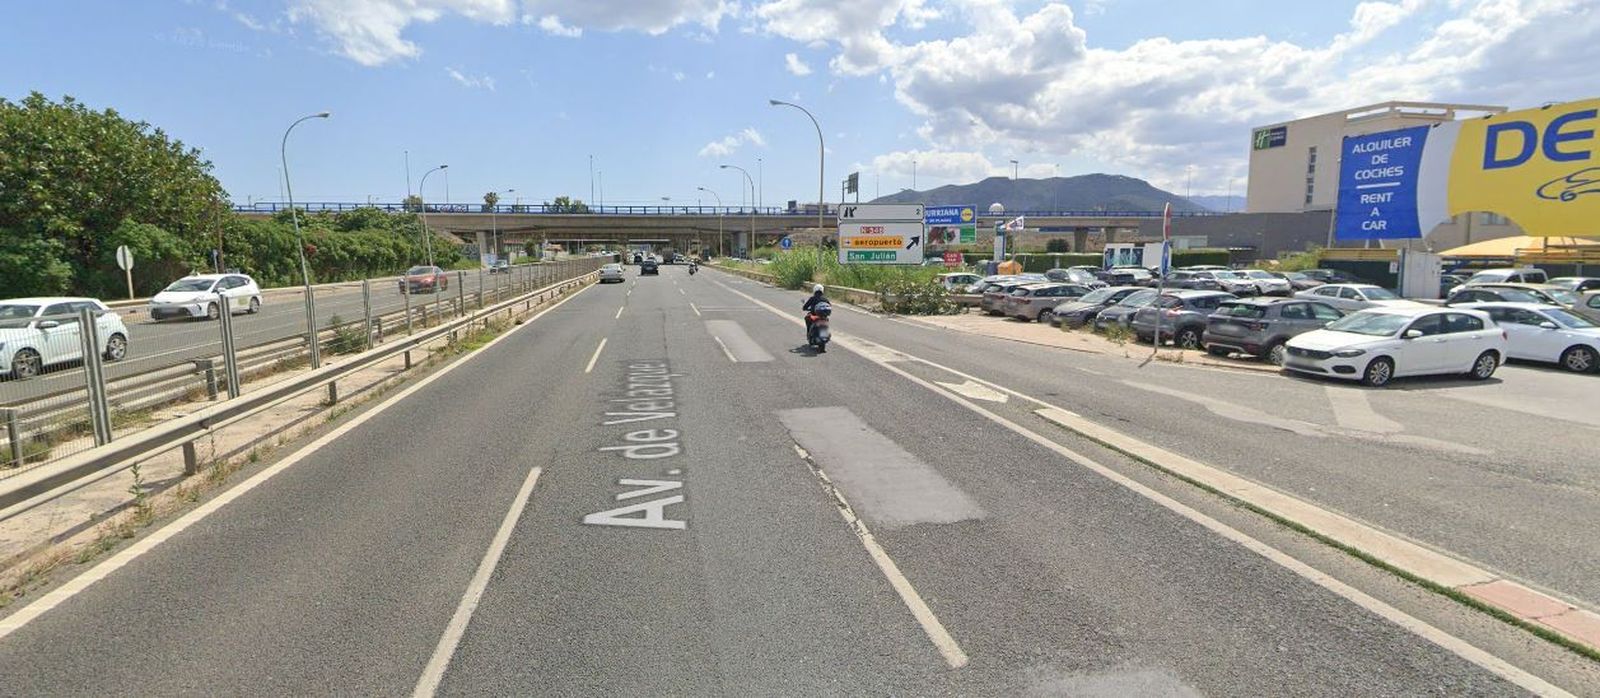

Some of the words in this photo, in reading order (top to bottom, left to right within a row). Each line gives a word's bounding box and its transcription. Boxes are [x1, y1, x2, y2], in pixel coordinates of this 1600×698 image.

[1352, 136, 1412, 154] ALQUILER
[1483, 109, 1598, 170] DE
[1371, 153, 1389, 165] DE
[1354, 166, 1404, 180] COCHES
[1360, 192, 1394, 204] RENT
[1370, 207, 1380, 217] A
[1362, 220, 1388, 230] CAR
[854, 238, 902, 246] aeropuerto
[849, 251, 865, 260] San
[600, 428, 679, 459] de
[583, 468, 687, 530] Av.
